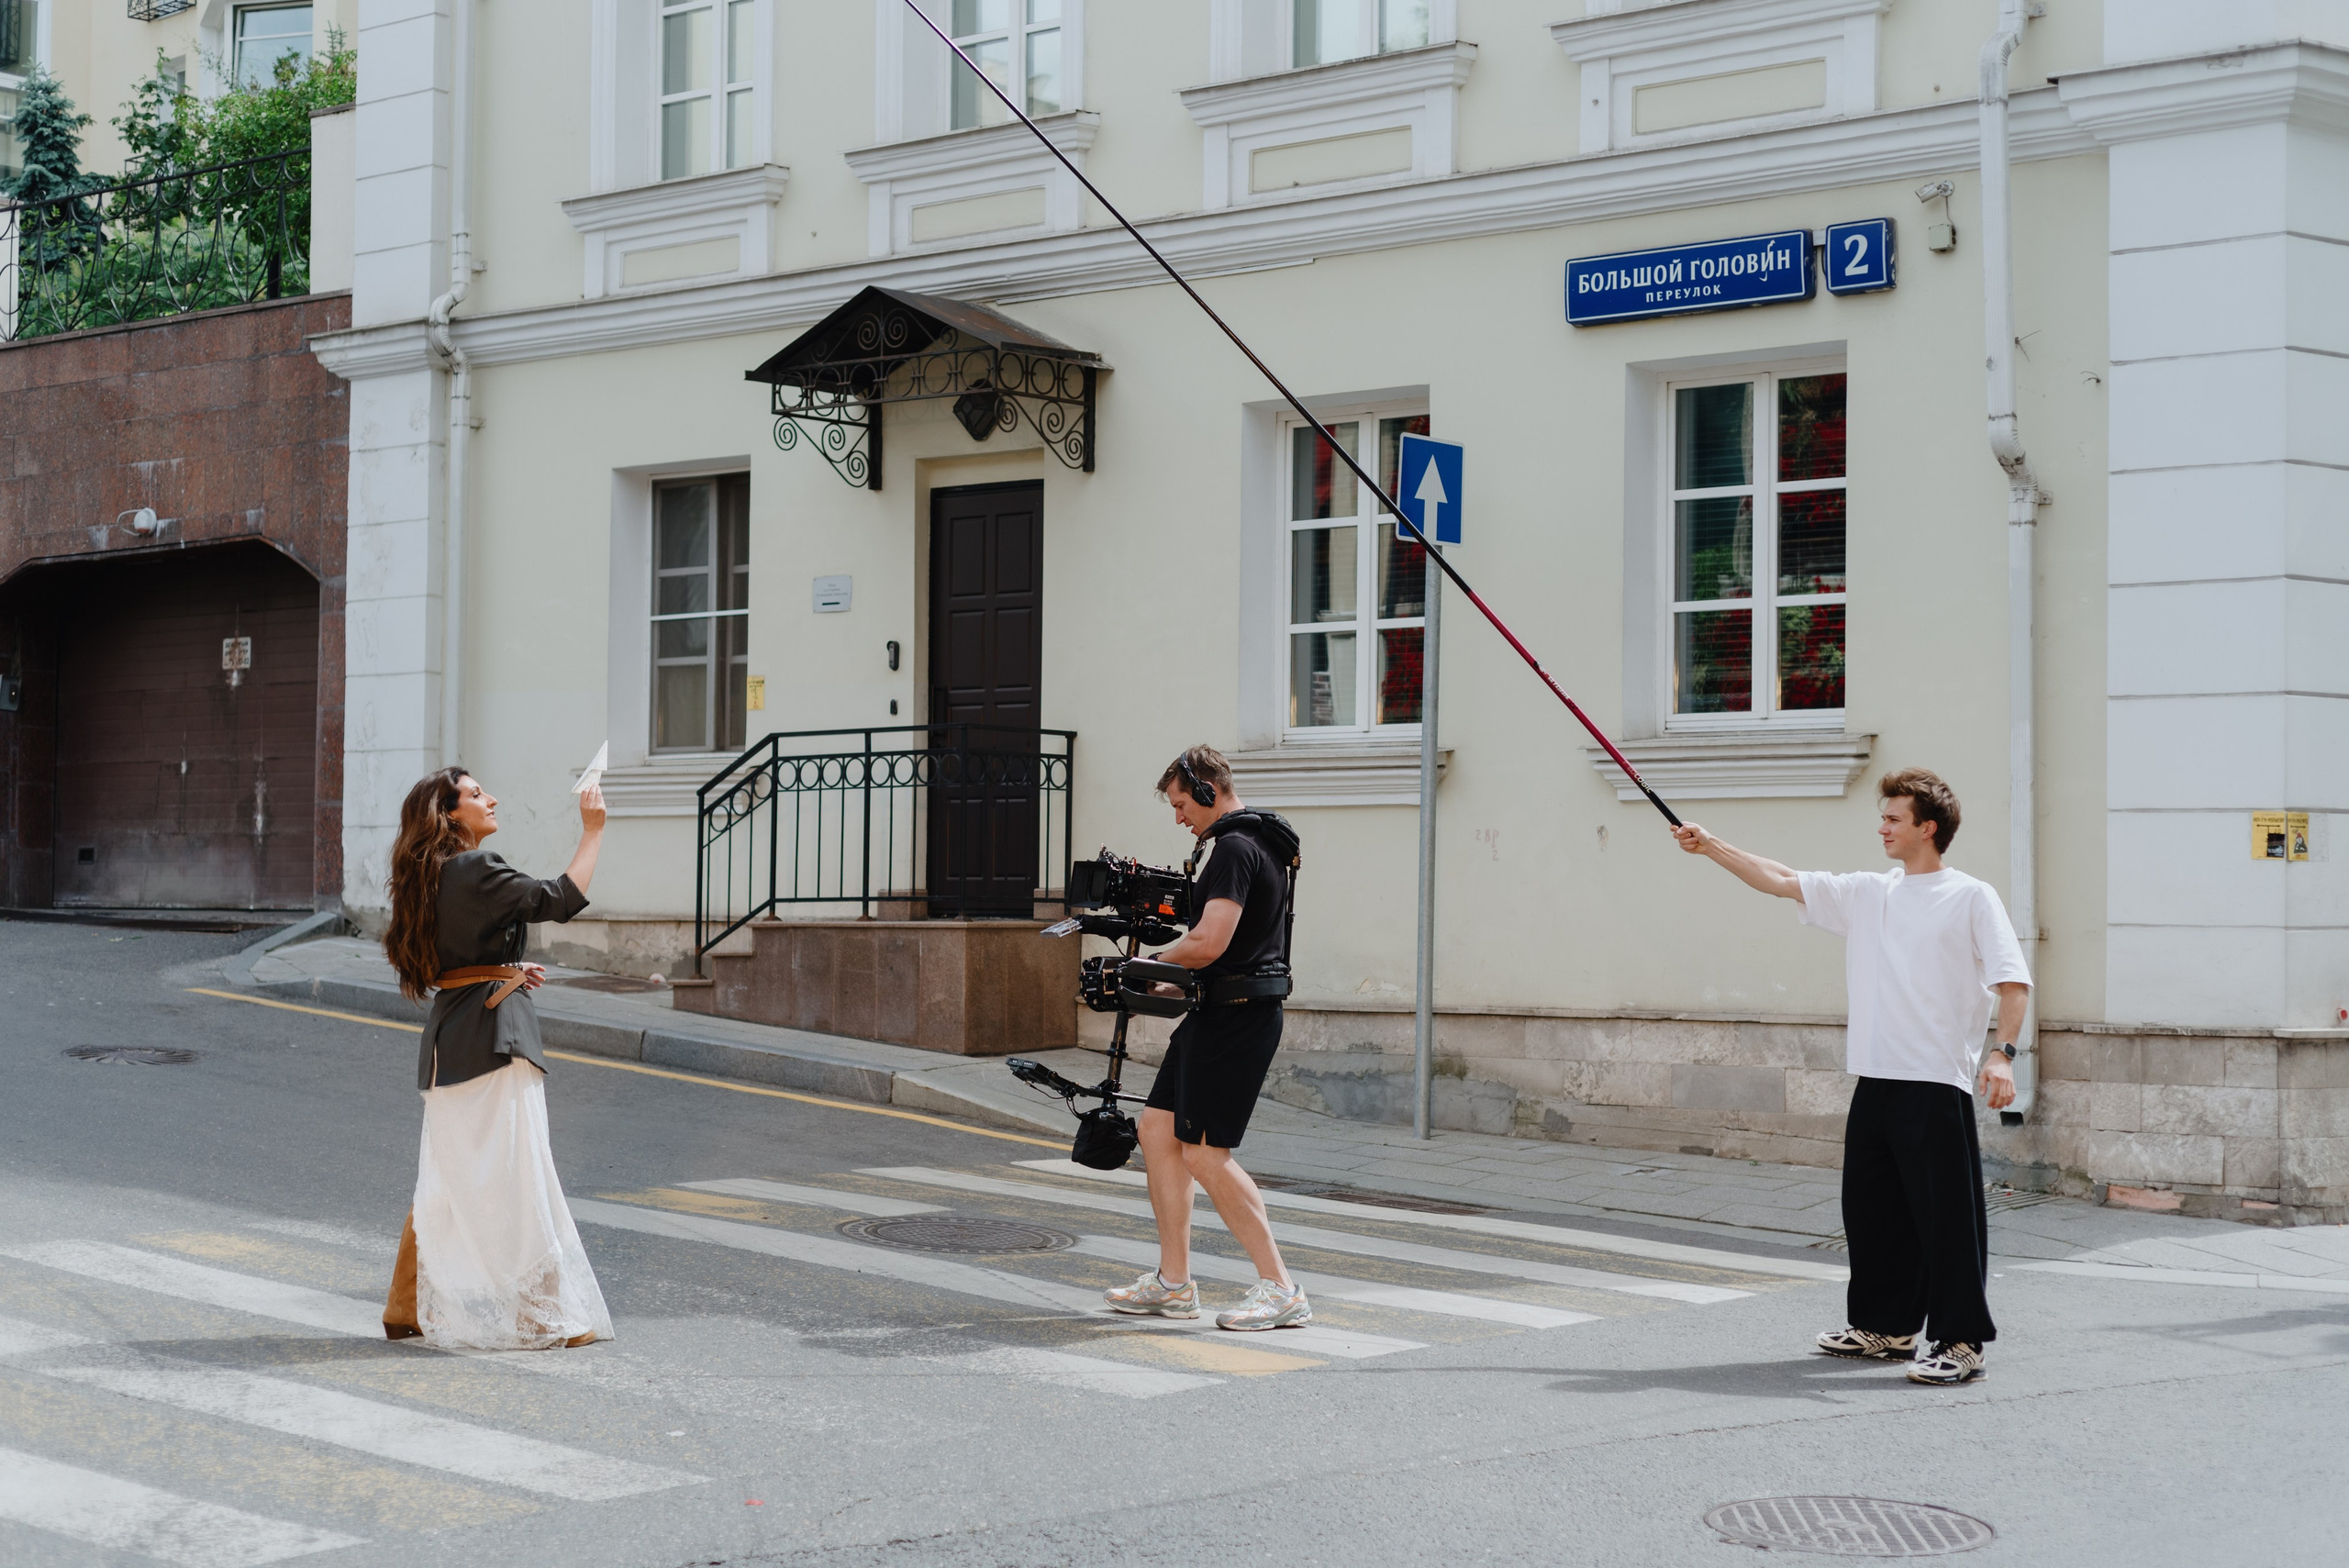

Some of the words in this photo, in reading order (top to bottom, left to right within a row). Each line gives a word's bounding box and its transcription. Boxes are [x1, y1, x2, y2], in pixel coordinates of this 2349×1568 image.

[1843, 233, 1869, 276] 2
[1578, 259, 1683, 295] БОЛЬШОЙ
[1645, 284, 1722, 303] ПЕРЕУЛОК
